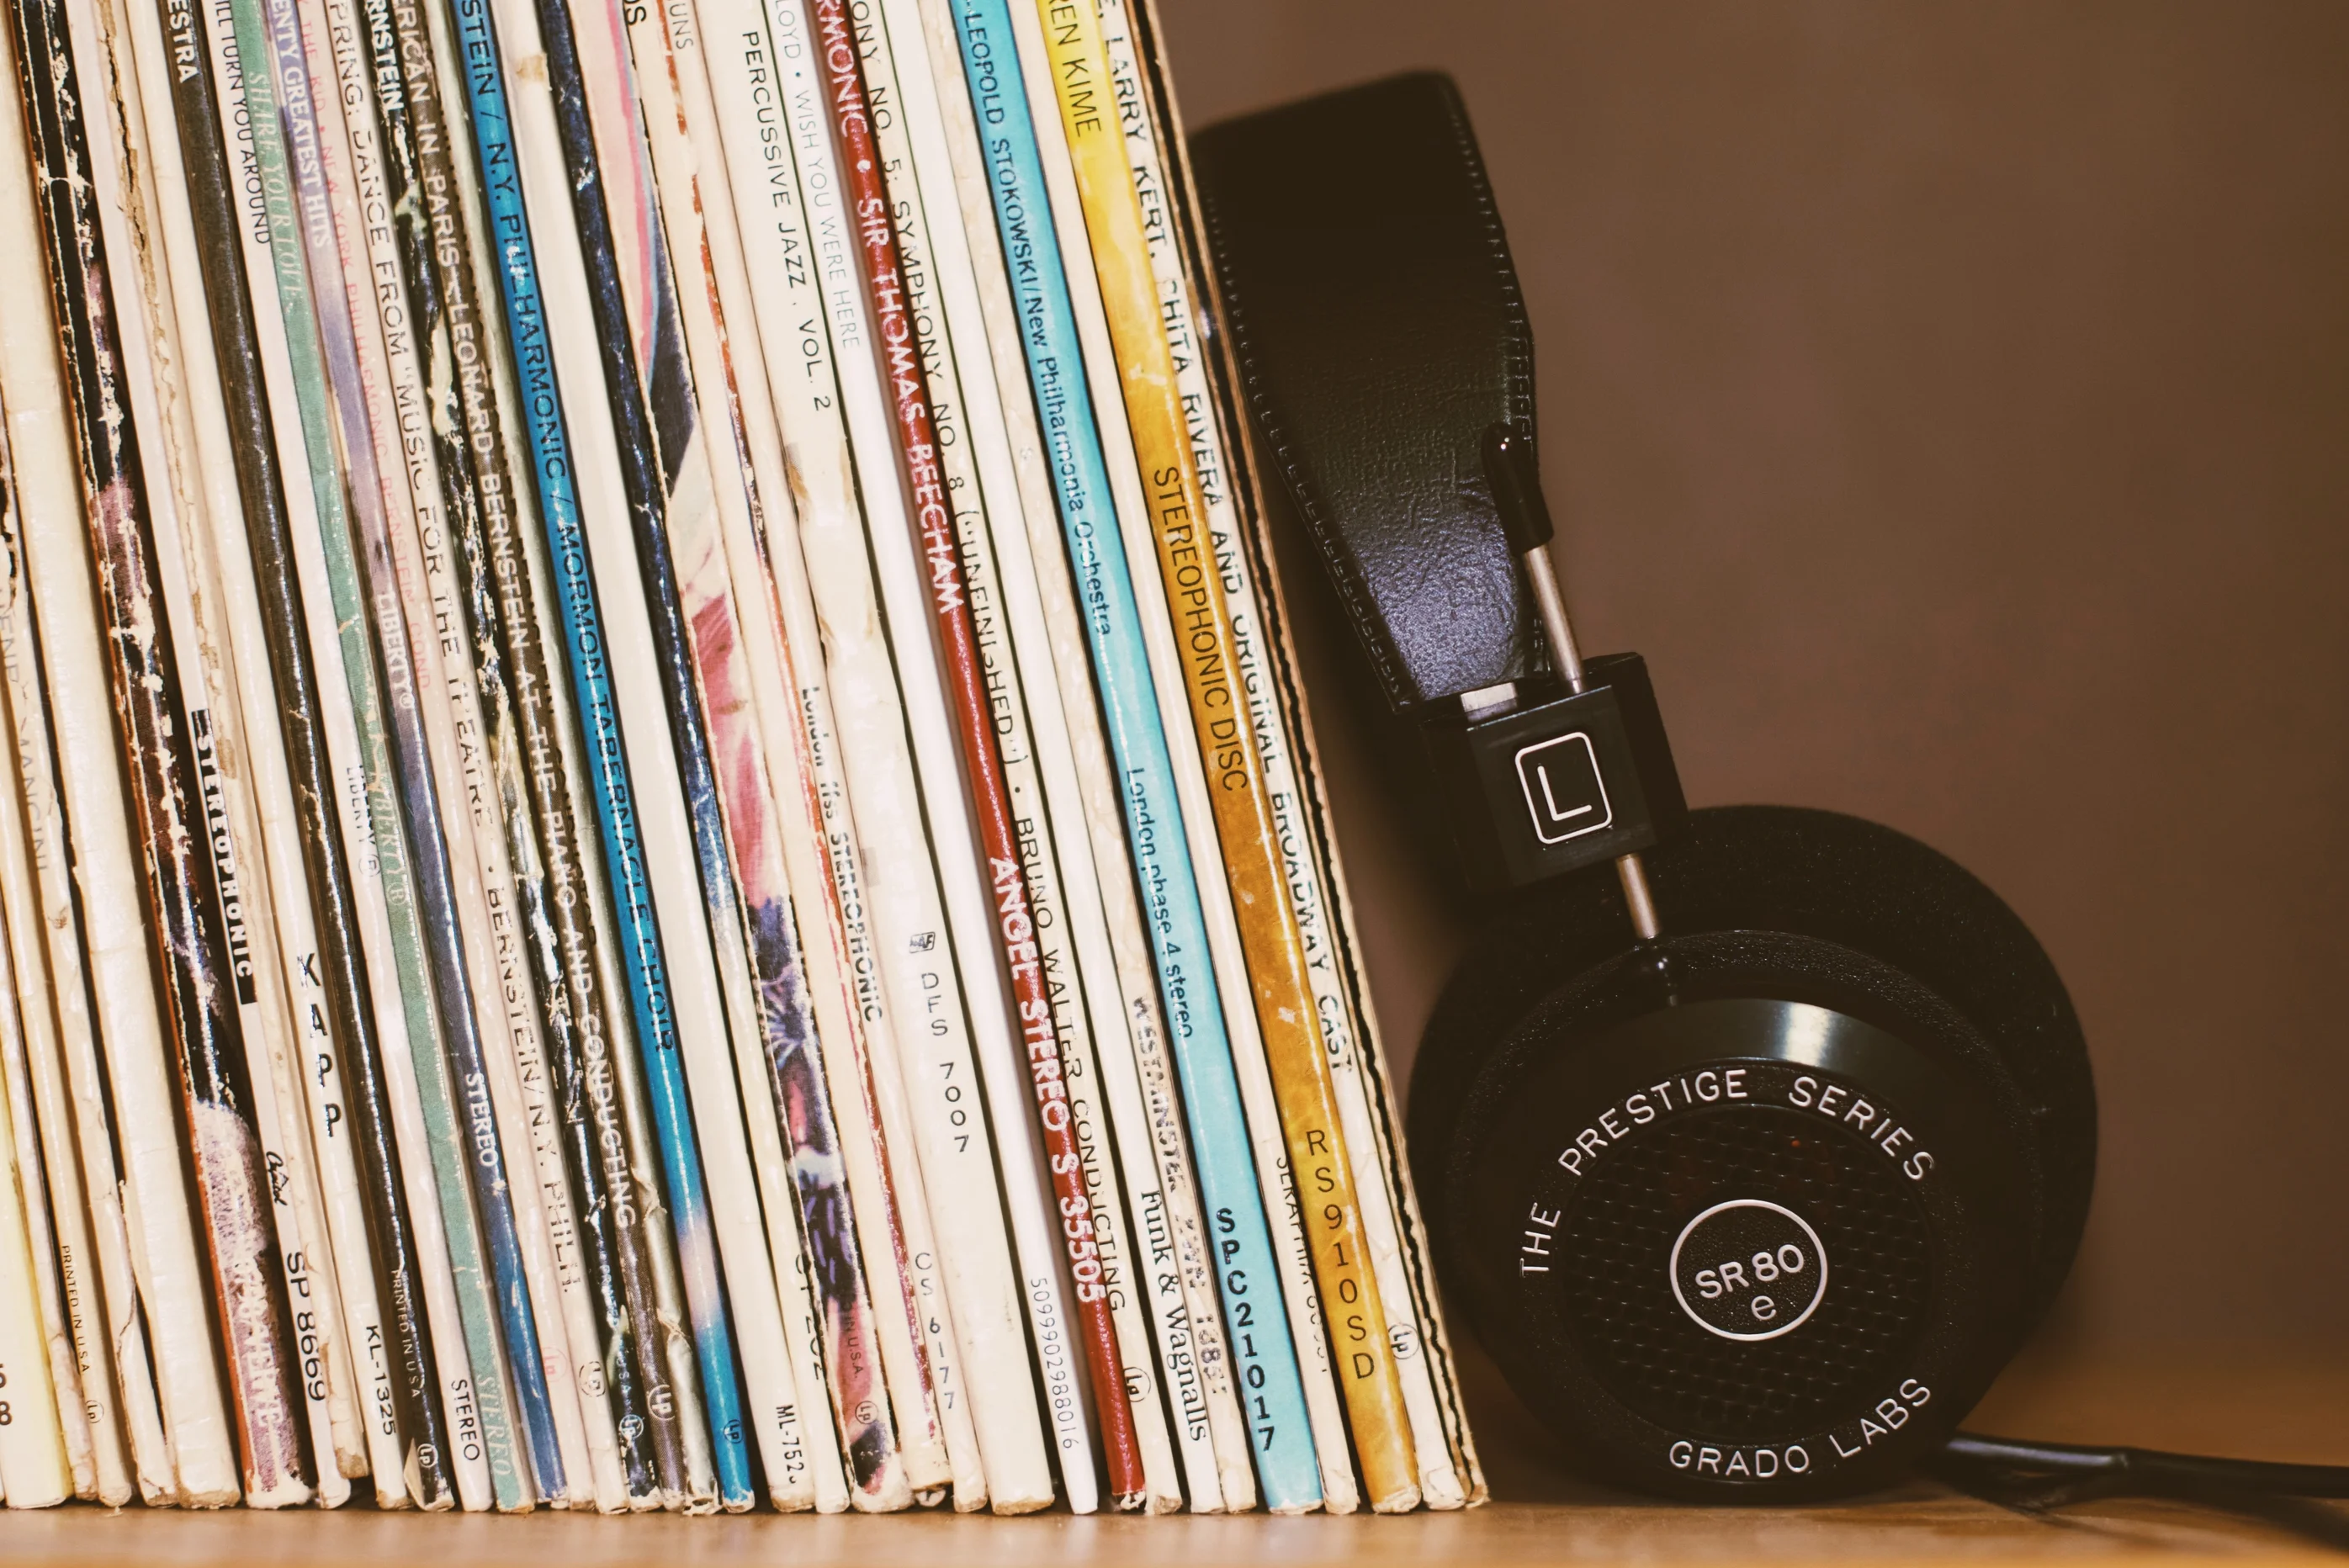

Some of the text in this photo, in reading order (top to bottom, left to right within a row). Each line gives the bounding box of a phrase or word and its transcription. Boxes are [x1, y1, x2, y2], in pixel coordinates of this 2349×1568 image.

[167, 0, 199, 83] ESTRA
[221, 35, 252, 91] TURN
[369, 0, 406, 111] RNSTEIN
[1048, 0, 1101, 139] EN KIME
[233, 98, 256, 142] YOU
[283, 66, 322, 188] GREATEST
[304, 194, 333, 247] HITS
[298, 21, 322, 61] THE
[319, 146, 341, 196] NEW
[332, 208, 356, 269] YORK
[412, 123, 440, 154] IN
[794, 89, 817, 151] WISH
[241, 149, 271, 245] AROUND
[247, 72, 303, 301] SHARE YOUR LOVE
[741, 30, 831, 411] PERCUSSIVE JAZZ VOL. 2
[803, 156, 832, 209] YOU
[856, 197, 890, 247] SIR
[816, 215, 844, 278] WERE
[830, 289, 861, 350] HERE
[871, 271, 925, 422] THOMAS
[352, 130, 390, 246] DANCE
[375, 261, 409, 358] FROM
[418, 505, 445, 575] FOR
[433, 591, 461, 658] THE
[1036, 355, 1086, 513] Philharmonia
[461, 0, 675, 1052] STEIN N.Y. PHILHARMONIC MORMON TABERNACLE CHOIR
[483, 474, 530, 649] BERNSTEIN
[906, 442, 964, 614] BEECHAM
[1104, 36, 1149, 142] LARRY
[1180, 393, 1225, 506] RIVERA
[1208, 529, 1244, 595] AND
[1232, 614, 1284, 774] ORIGINAL
[1270, 792, 1331, 971] BROADWAY
[1318, 995, 1353, 1074] CAST
[1074, 521, 1115, 636] Orchestra
[851, 1, 881, 65] ONY
[893, 200, 944, 380] SYMPHONY
[931, 404, 957, 457] NO.
[947, 477, 965, 490] 8
[1015, 818, 1054, 930] BRUNO
[1043, 949, 1084, 1080] WALTER
[1071, 1099, 1126, 1312] CONDUCTING
[1153, 466, 1249, 792] STEREOPHONIC DISC
[517, 670, 542, 709] AT
[347, 766, 375, 845] LIBERTY
[527, 726, 556, 792] THE
[1537, 765, 1592, 821] L
[197, 735, 251, 977] STEREOPHONIC
[540, 811, 578, 907] PIANO
[802, 686, 834, 767] London
[830, 831, 883, 1023] STEREOPHONIC
[1126, 765, 1160, 856] London
[989, 856, 1037, 979] ANGEL
[1139, 865, 1175, 935] phase
[1161, 941, 1181, 958] 4
[560, 929, 594, 994] AND
[1165, 964, 1195, 1039] stereo
[939, 1062, 970, 1152] 7007
[1019, 998, 1071, 1131] STEREO
[463, 1072, 501, 1168] STEREO
[579, 1013, 638, 1228] CONDUCTING
[1050, 1152, 1079, 1176] S
[266, 1151, 290, 1206] Capitol
[1519, 1068, 1935, 1277] THE PRESTIGE SERIES
[62, 1246, 79, 1307] PRINTED
[73, 1315, 82, 1329] IN
[1058, 1196, 1106, 1306] 35505
[287, 1252, 326, 1403] SP 8669
[391, 1269, 409, 1332] PRINTED
[403, 1338, 414, 1354] IN
[1139, 1191, 1210, 1443] Funk & Wagnalls
[1751, 1295, 1777, 1321] e
[367, 1324, 397, 1437] KL-1325
[1030, 1277, 1076, 1449] 5099902988016
[451, 1379, 480, 1461] STEREO
[475, 1373, 513, 1476] STEREO
[1669, 1379, 1931, 1478] GRADO LABS
